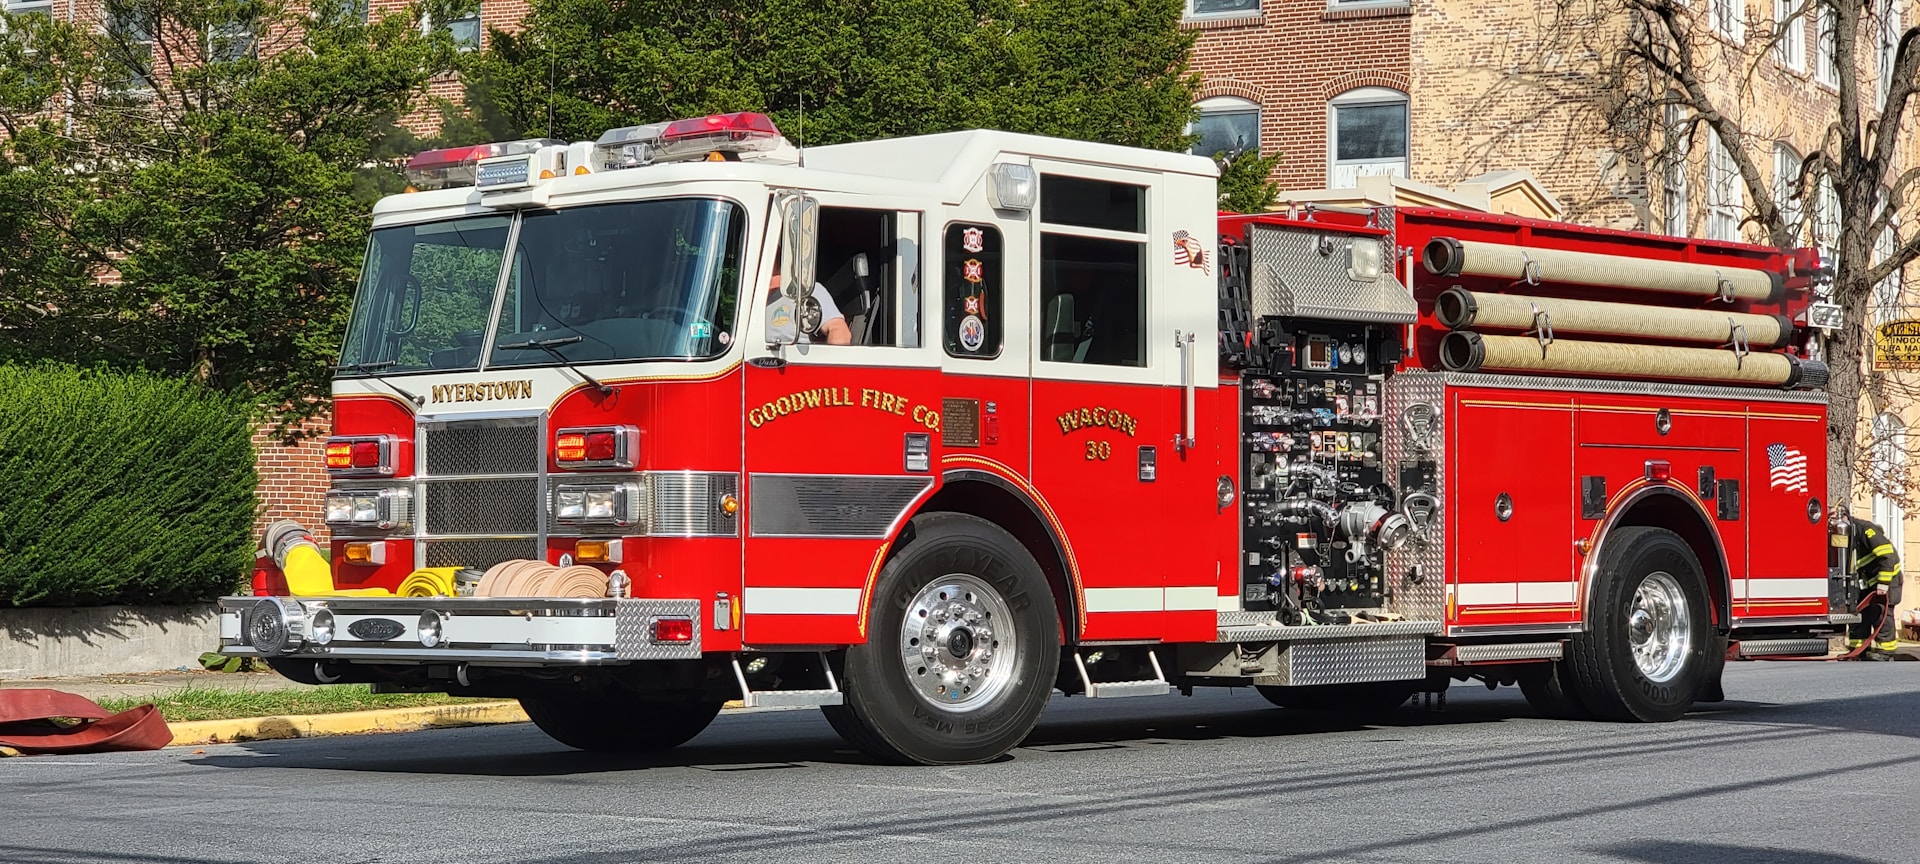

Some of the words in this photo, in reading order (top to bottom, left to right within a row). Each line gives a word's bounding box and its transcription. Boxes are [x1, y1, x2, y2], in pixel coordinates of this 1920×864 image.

[431, 380, 533, 404] MYERSTOWN
[748, 387, 855, 428] GOODWILL
[860, 388, 909, 416] FIRE
[912, 404, 941, 433] CO.
[1056, 406, 1138, 437] WAGON
[1086, 440, 1111, 460] 30
